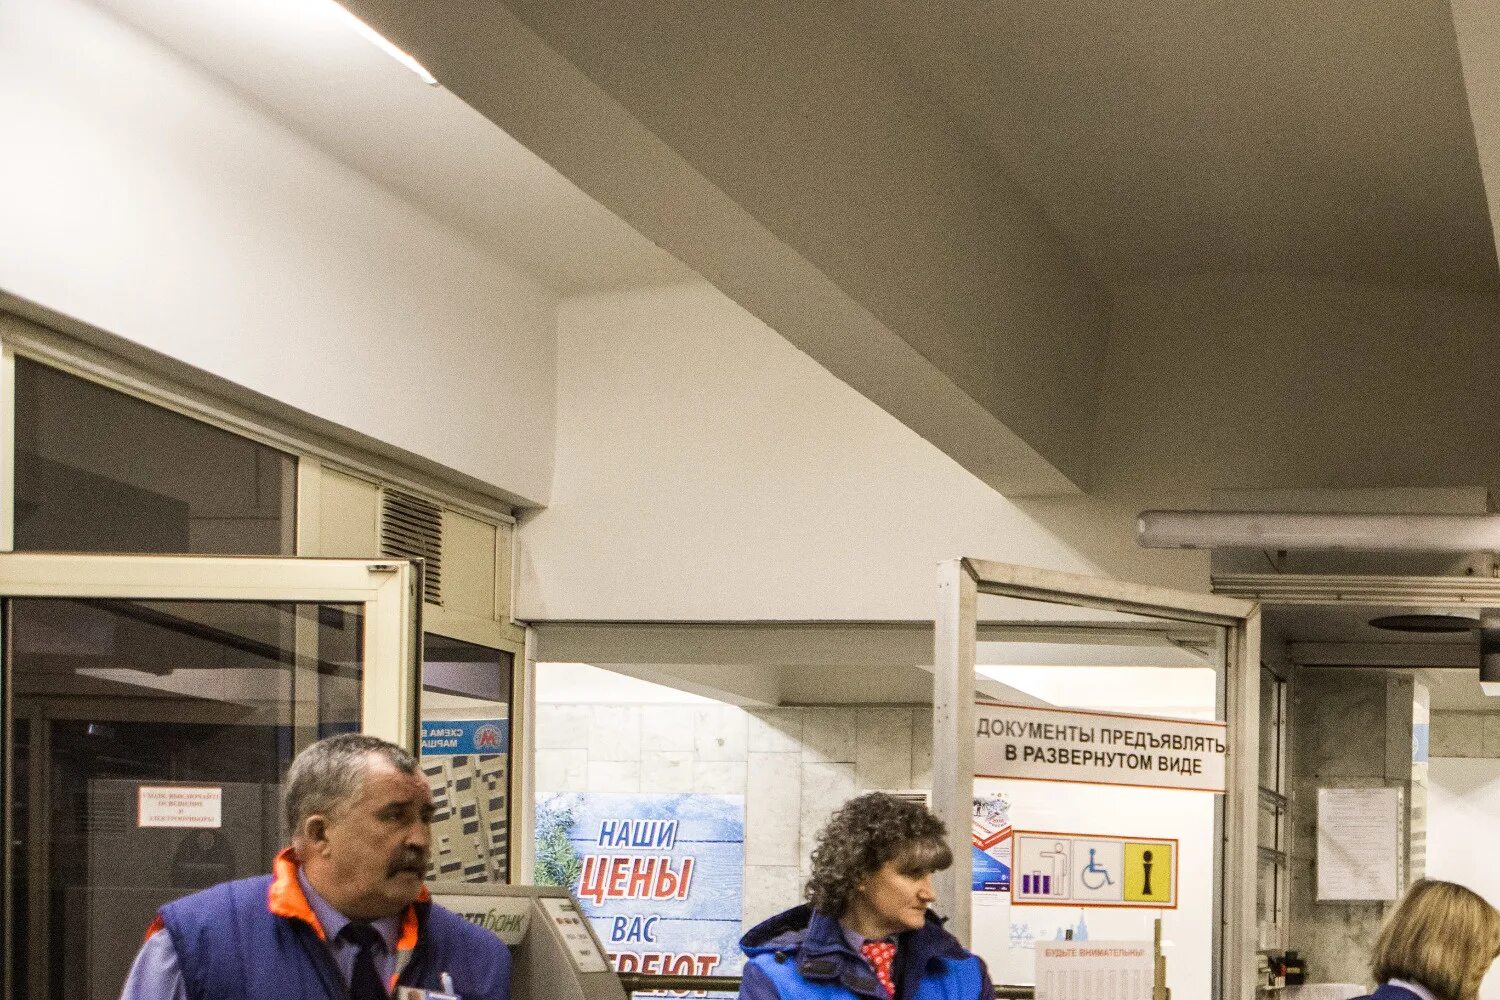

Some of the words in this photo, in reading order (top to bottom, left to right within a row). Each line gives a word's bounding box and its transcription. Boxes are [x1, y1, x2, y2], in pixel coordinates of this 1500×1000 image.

[977, 718, 1095, 743] ДОКУМЕНТЫ
[1101, 728, 1226, 754] ПРЕДЪЯВЛЯТЬ
[1005, 745, 1017, 761] В
[1023, 746, 1152, 770] РАЗВЕРНУТОМ
[1158, 757, 1203, 775] ВИДЕ
[599, 821, 676, 848] НАШИ
[580, 856, 693, 905] ЦЕНЫ
[611, 916, 659, 943] ВАС
[1045, 949, 1076, 957] БУДЬТЕ
[608, 953, 718, 994] РЕЮТ
